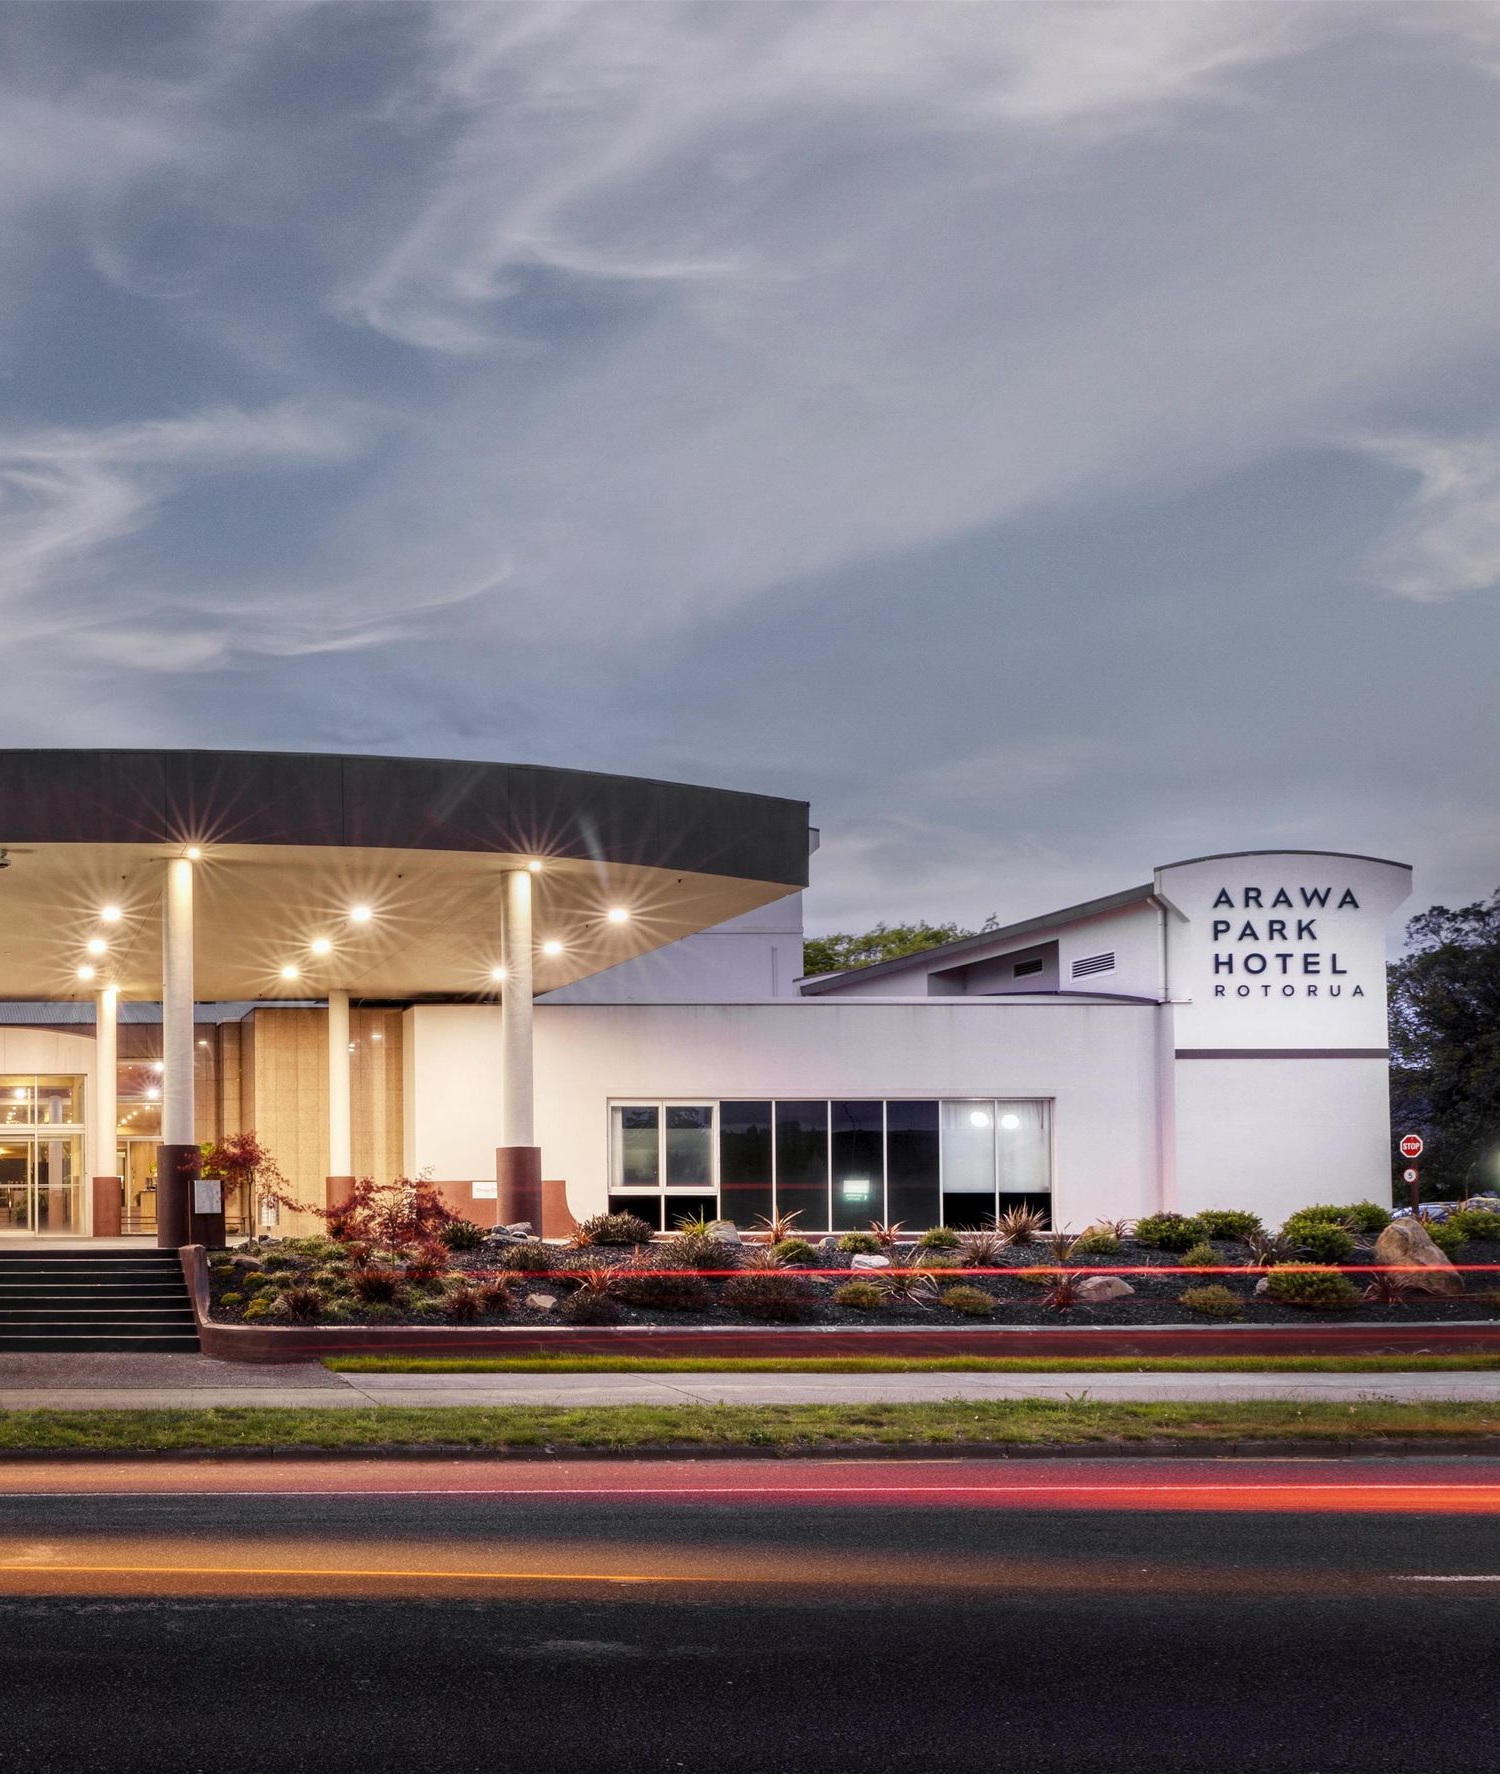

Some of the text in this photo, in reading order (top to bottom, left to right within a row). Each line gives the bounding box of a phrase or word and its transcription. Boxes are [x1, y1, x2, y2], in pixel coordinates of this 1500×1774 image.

[1212, 887, 1360, 909] ARAWA
[1213, 918, 1318, 941] PARK
[1214, 952, 1348, 974] HOTEL
[1215, 984, 1364, 997] ROTORUA
[1402, 1142, 1420, 1150] STOP
